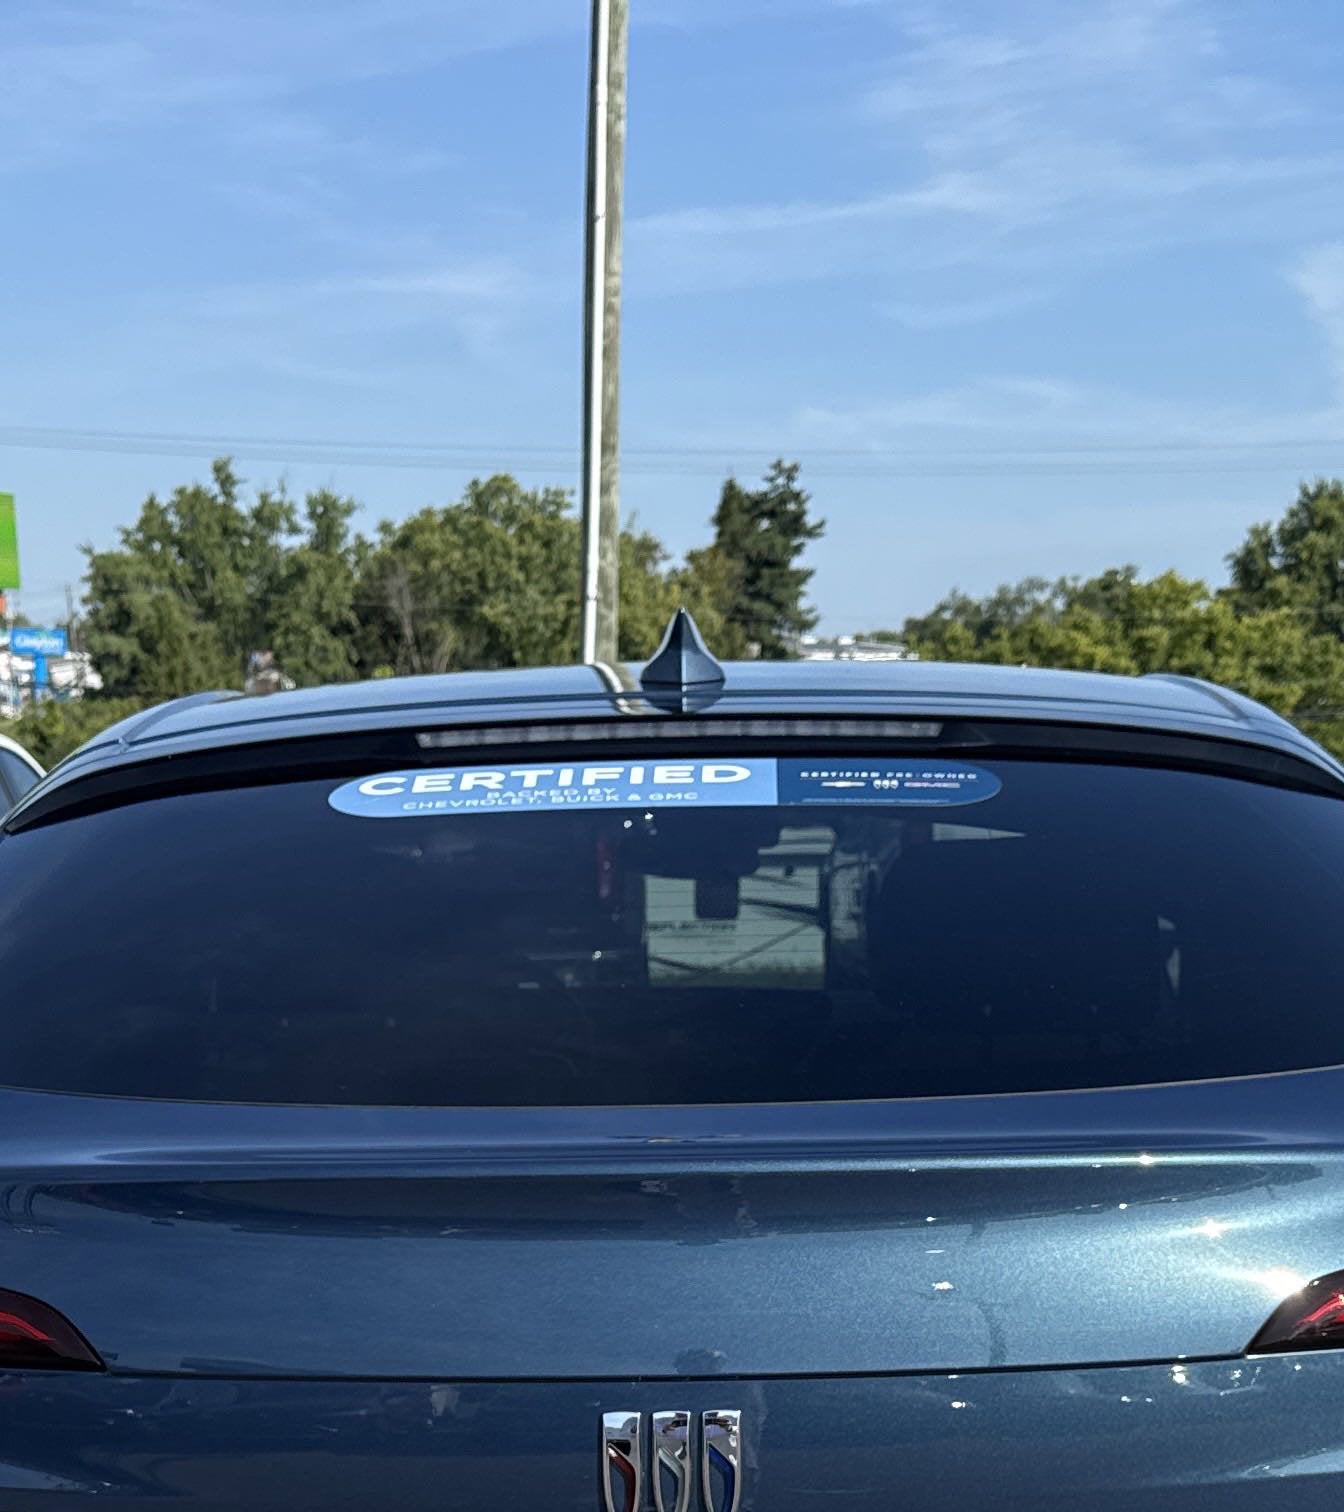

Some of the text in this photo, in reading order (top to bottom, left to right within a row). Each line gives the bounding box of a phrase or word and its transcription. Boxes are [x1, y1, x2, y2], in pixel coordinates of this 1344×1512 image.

[358, 765, 751, 796] CERTIFIED
[486, 787, 617, 800] BACKED BY
[551, 793, 621, 804] BUICK
[649, 792, 698, 801] GMC
